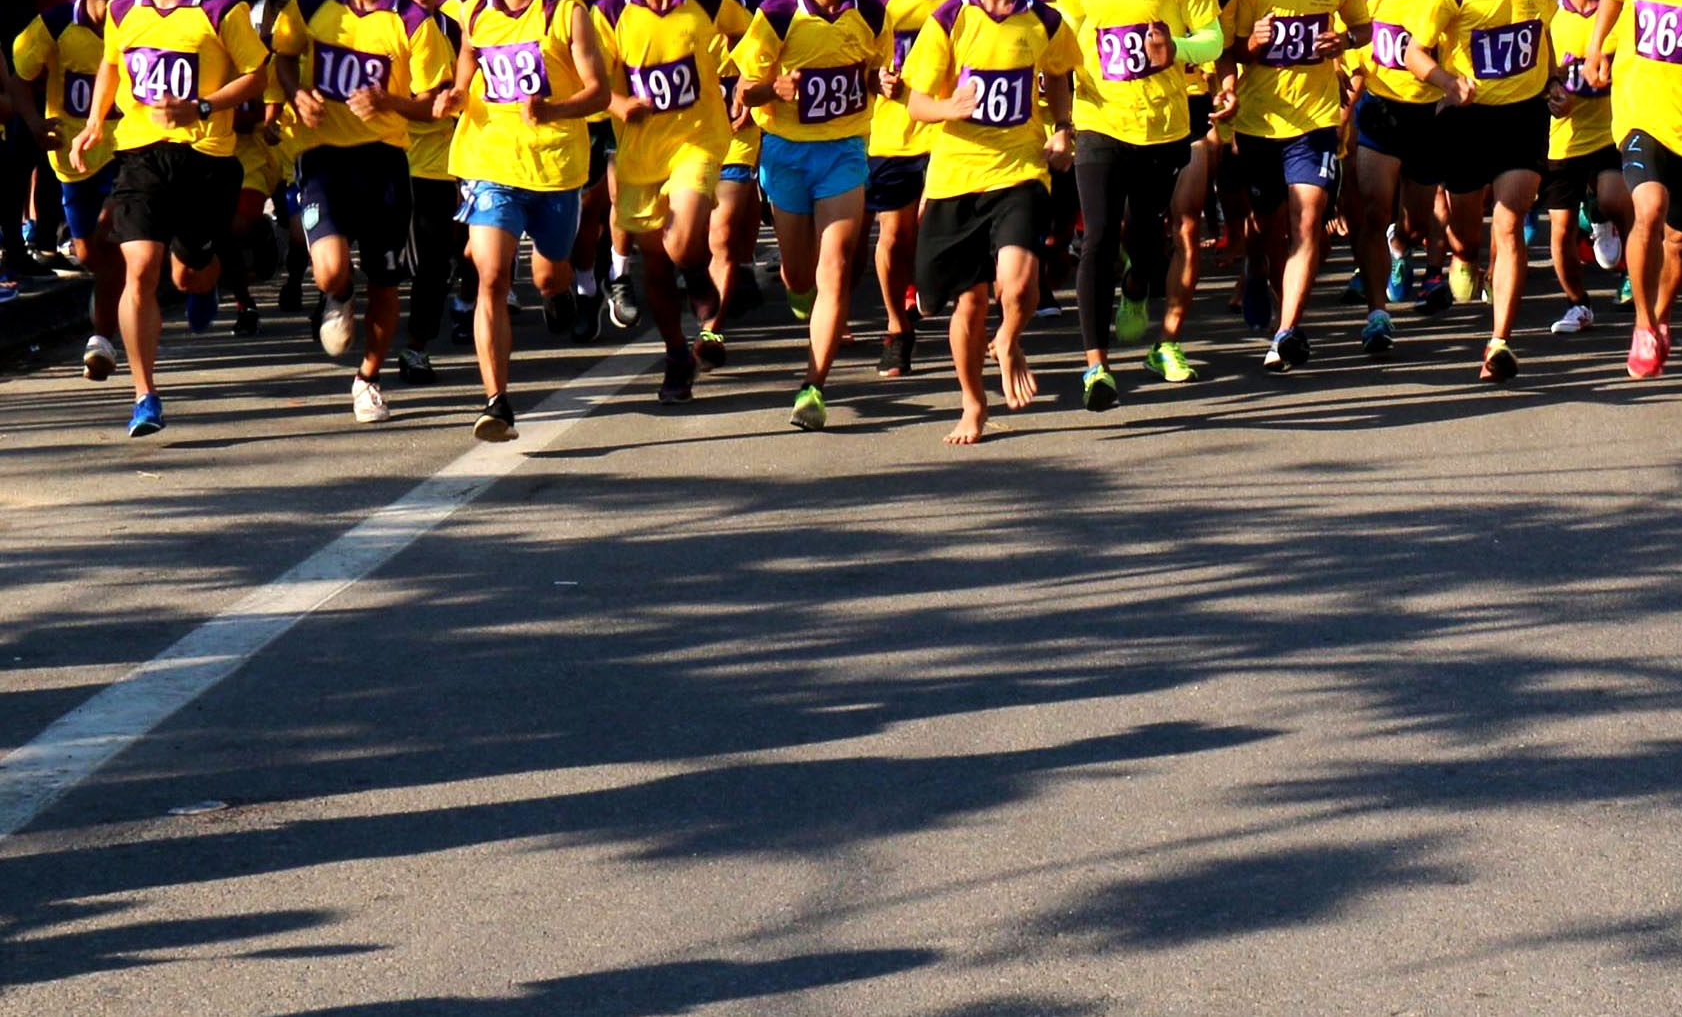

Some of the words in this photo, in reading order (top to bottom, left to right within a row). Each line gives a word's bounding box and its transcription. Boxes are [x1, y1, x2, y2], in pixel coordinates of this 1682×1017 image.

[1102, 30, 1157, 74] 23
[1266, 21, 1321, 60] 231
[1478, 28, 1531, 74] 178
[132, 52, 192, 101] 240
[320, 50, 383, 98] 103
[478, 51, 541, 99] 193
[631, 65, 695, 110] 192
[807, 69, 864, 118] 234
[968, 75, 1023, 122] 261
